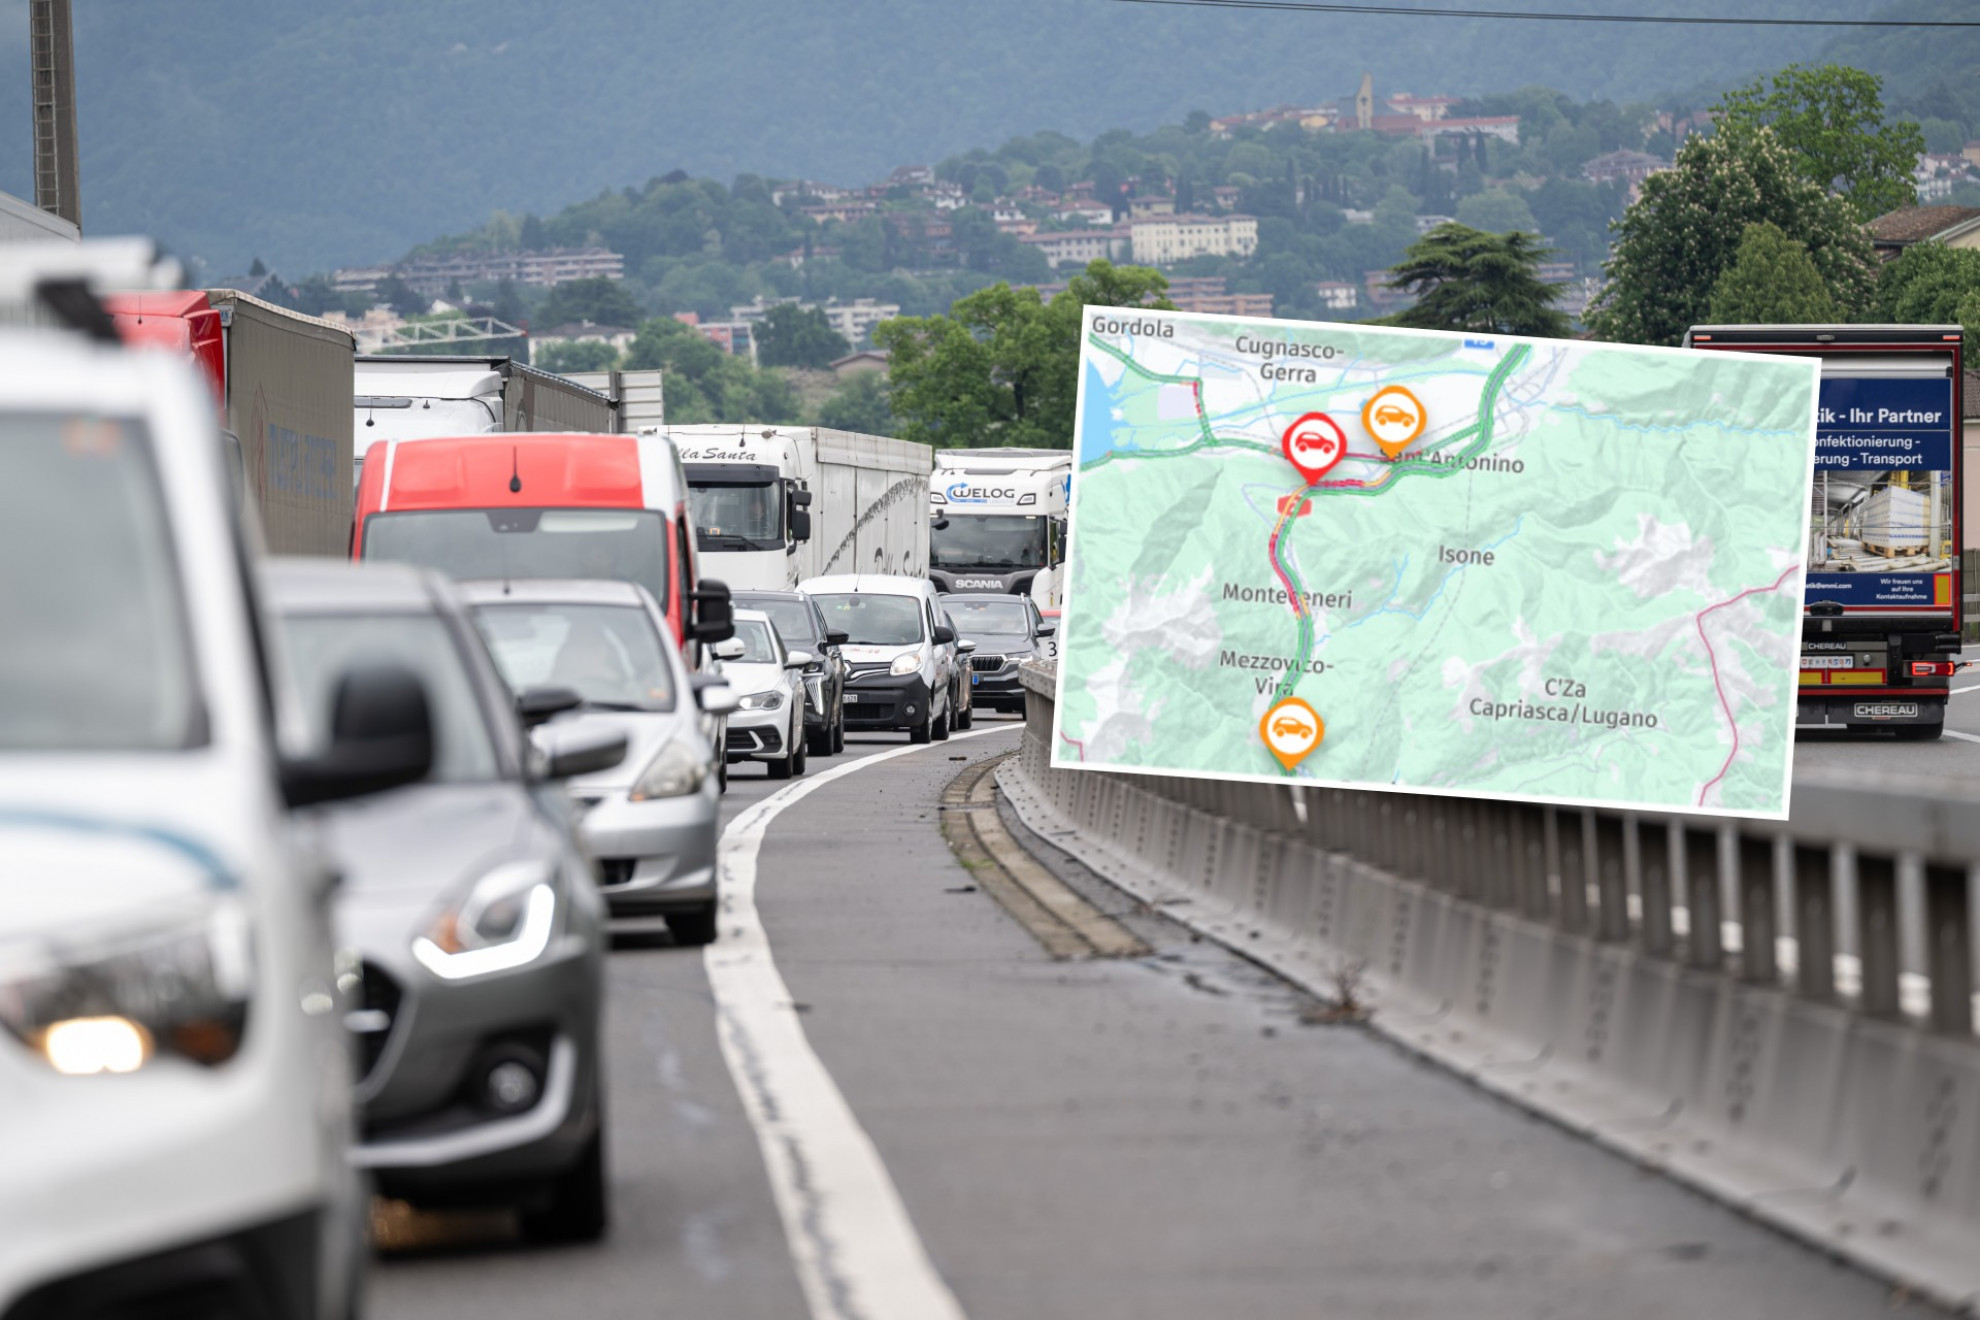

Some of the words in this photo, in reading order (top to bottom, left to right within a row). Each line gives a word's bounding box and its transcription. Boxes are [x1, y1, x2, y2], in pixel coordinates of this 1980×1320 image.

[1850, 408, 1873, 423] Ihr
[1878, 408, 1941, 423] Partner
[702, 447, 757, 461] Santa
[1860, 452, 1922, 467] Transport
[953, 488, 1015, 499] WELOG
[955, 579, 1003, 589] SCANIA
[1048, 641, 1057, 657] 3
[1808, 642, 1846, 650] CHEREAU
[1857, 705, 1915, 715] CHEREAU
